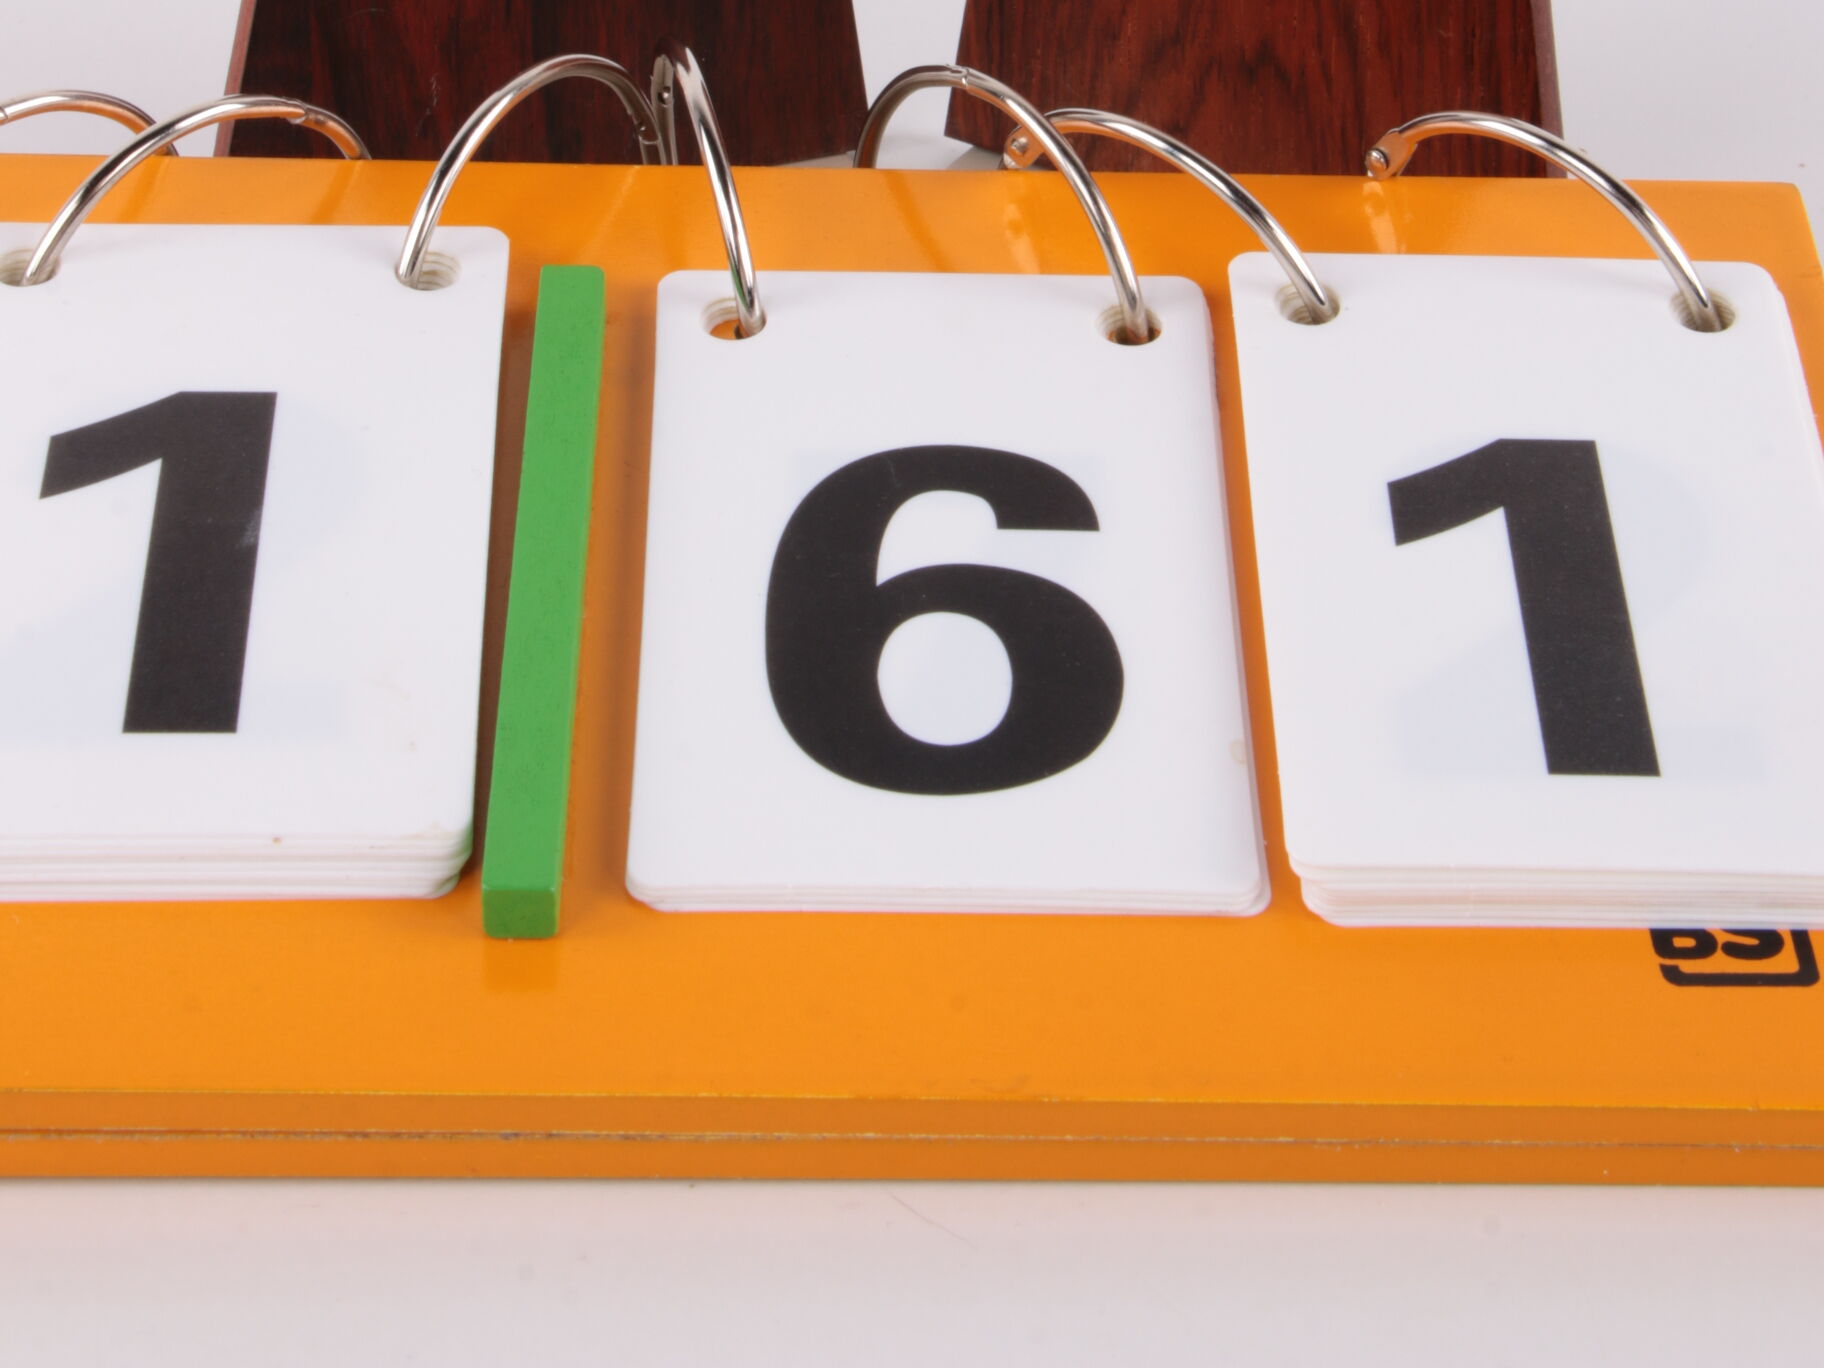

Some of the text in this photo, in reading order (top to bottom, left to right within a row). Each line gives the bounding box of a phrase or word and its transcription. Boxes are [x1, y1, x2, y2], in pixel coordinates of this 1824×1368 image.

[39, 390, 1660, 796] 1 6 1
